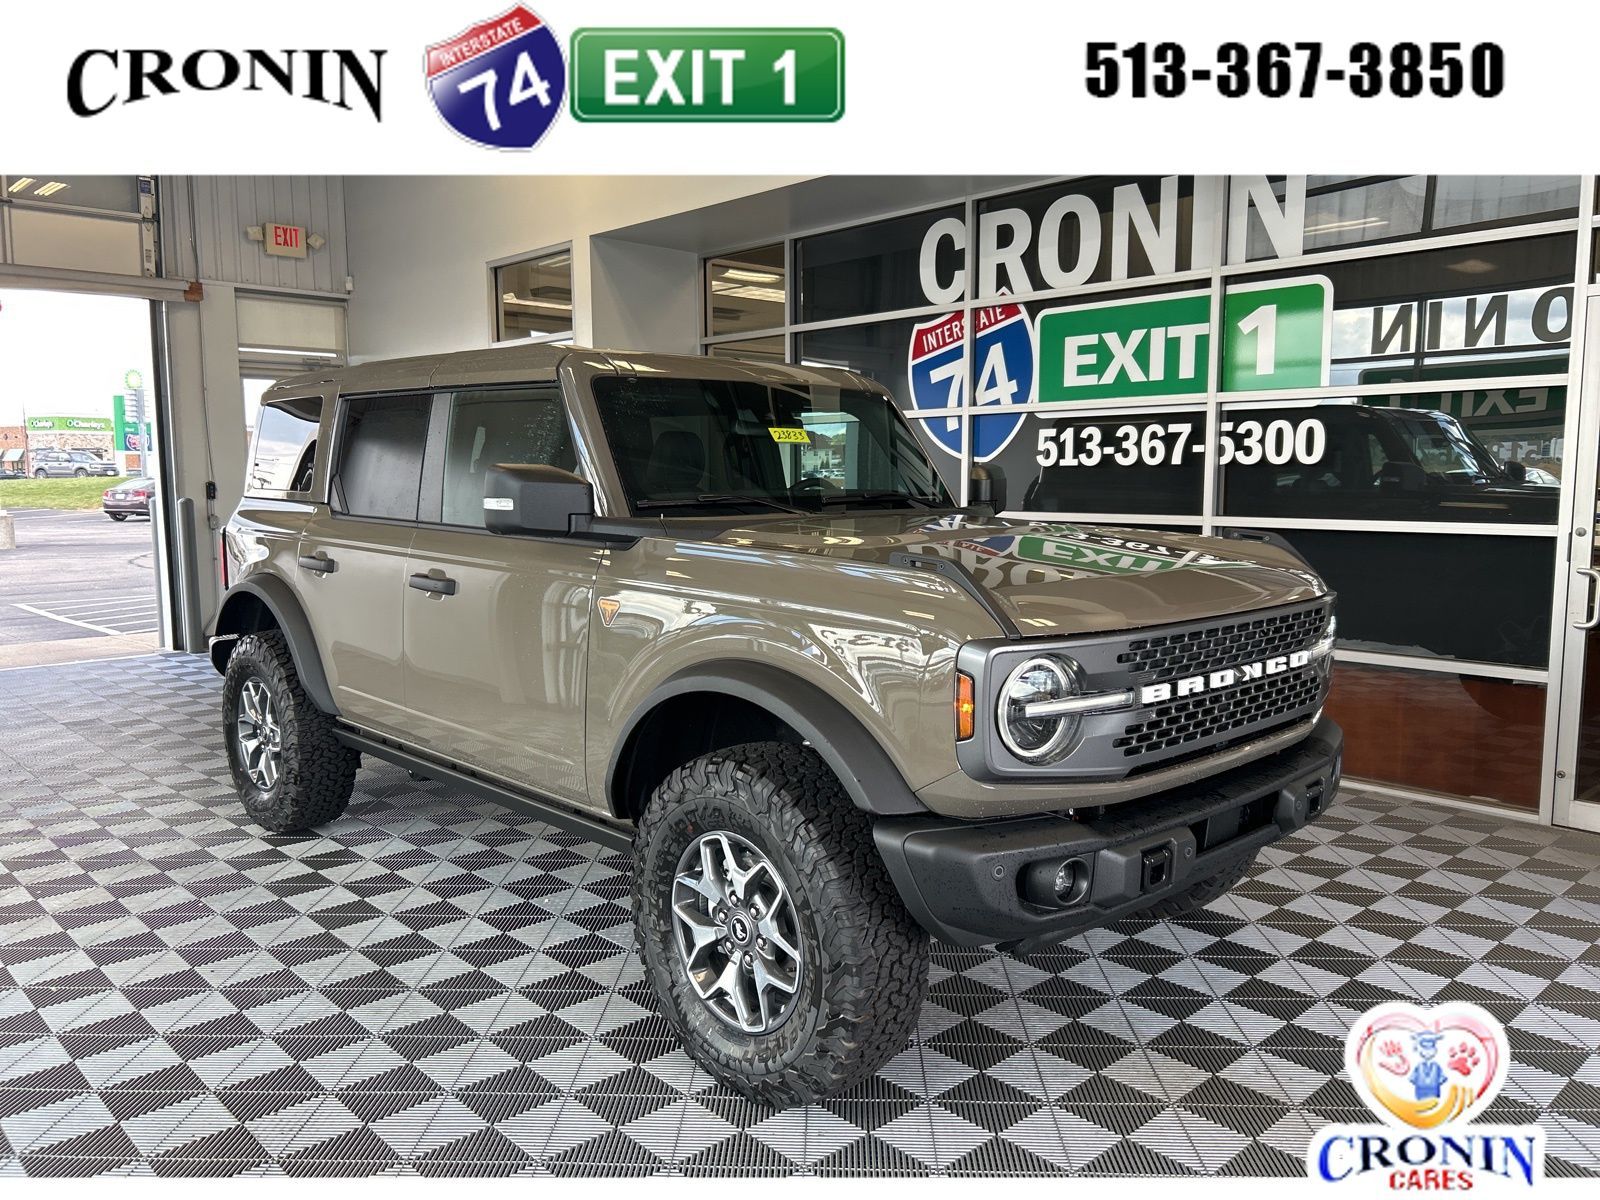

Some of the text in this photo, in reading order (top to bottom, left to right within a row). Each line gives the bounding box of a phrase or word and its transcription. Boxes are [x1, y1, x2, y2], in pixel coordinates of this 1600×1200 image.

[273, 225, 299, 249] EXIT
[919, 175, 1306, 306] CRONIN
[1063, 304, 1277, 388] EXIT 1
[929, 342, 1018, 433] 74
[1035, 418, 1326, 467] 513-367-5300
[1140, 650, 1310, 705] BRONCO
